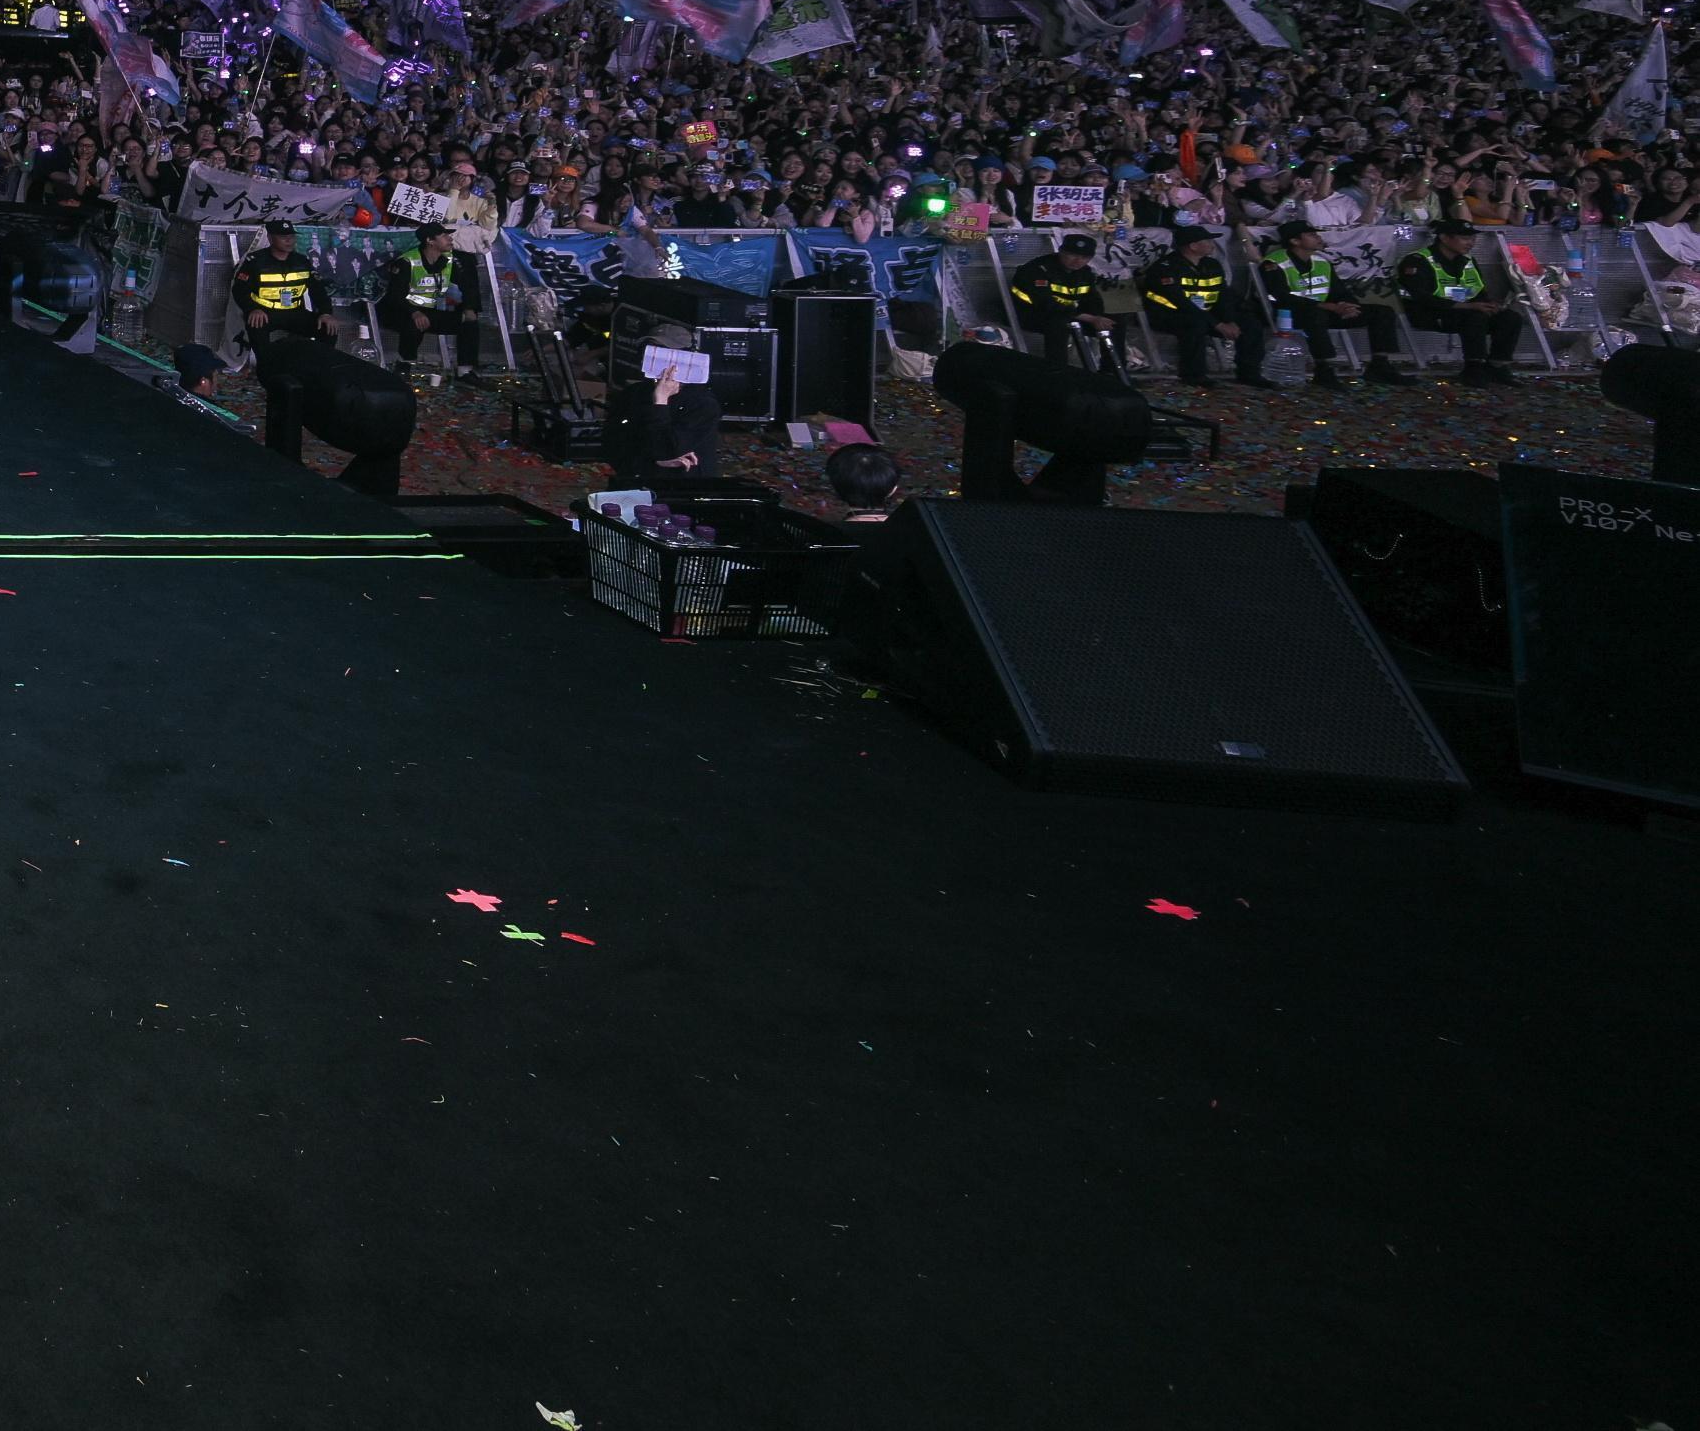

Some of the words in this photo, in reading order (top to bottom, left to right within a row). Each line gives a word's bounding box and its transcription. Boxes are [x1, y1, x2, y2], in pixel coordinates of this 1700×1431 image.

[403, 188, 437, 209] 指我
[1561, 510, 1635, 533] V107
[1654, 524, 1700, 542] Ne
